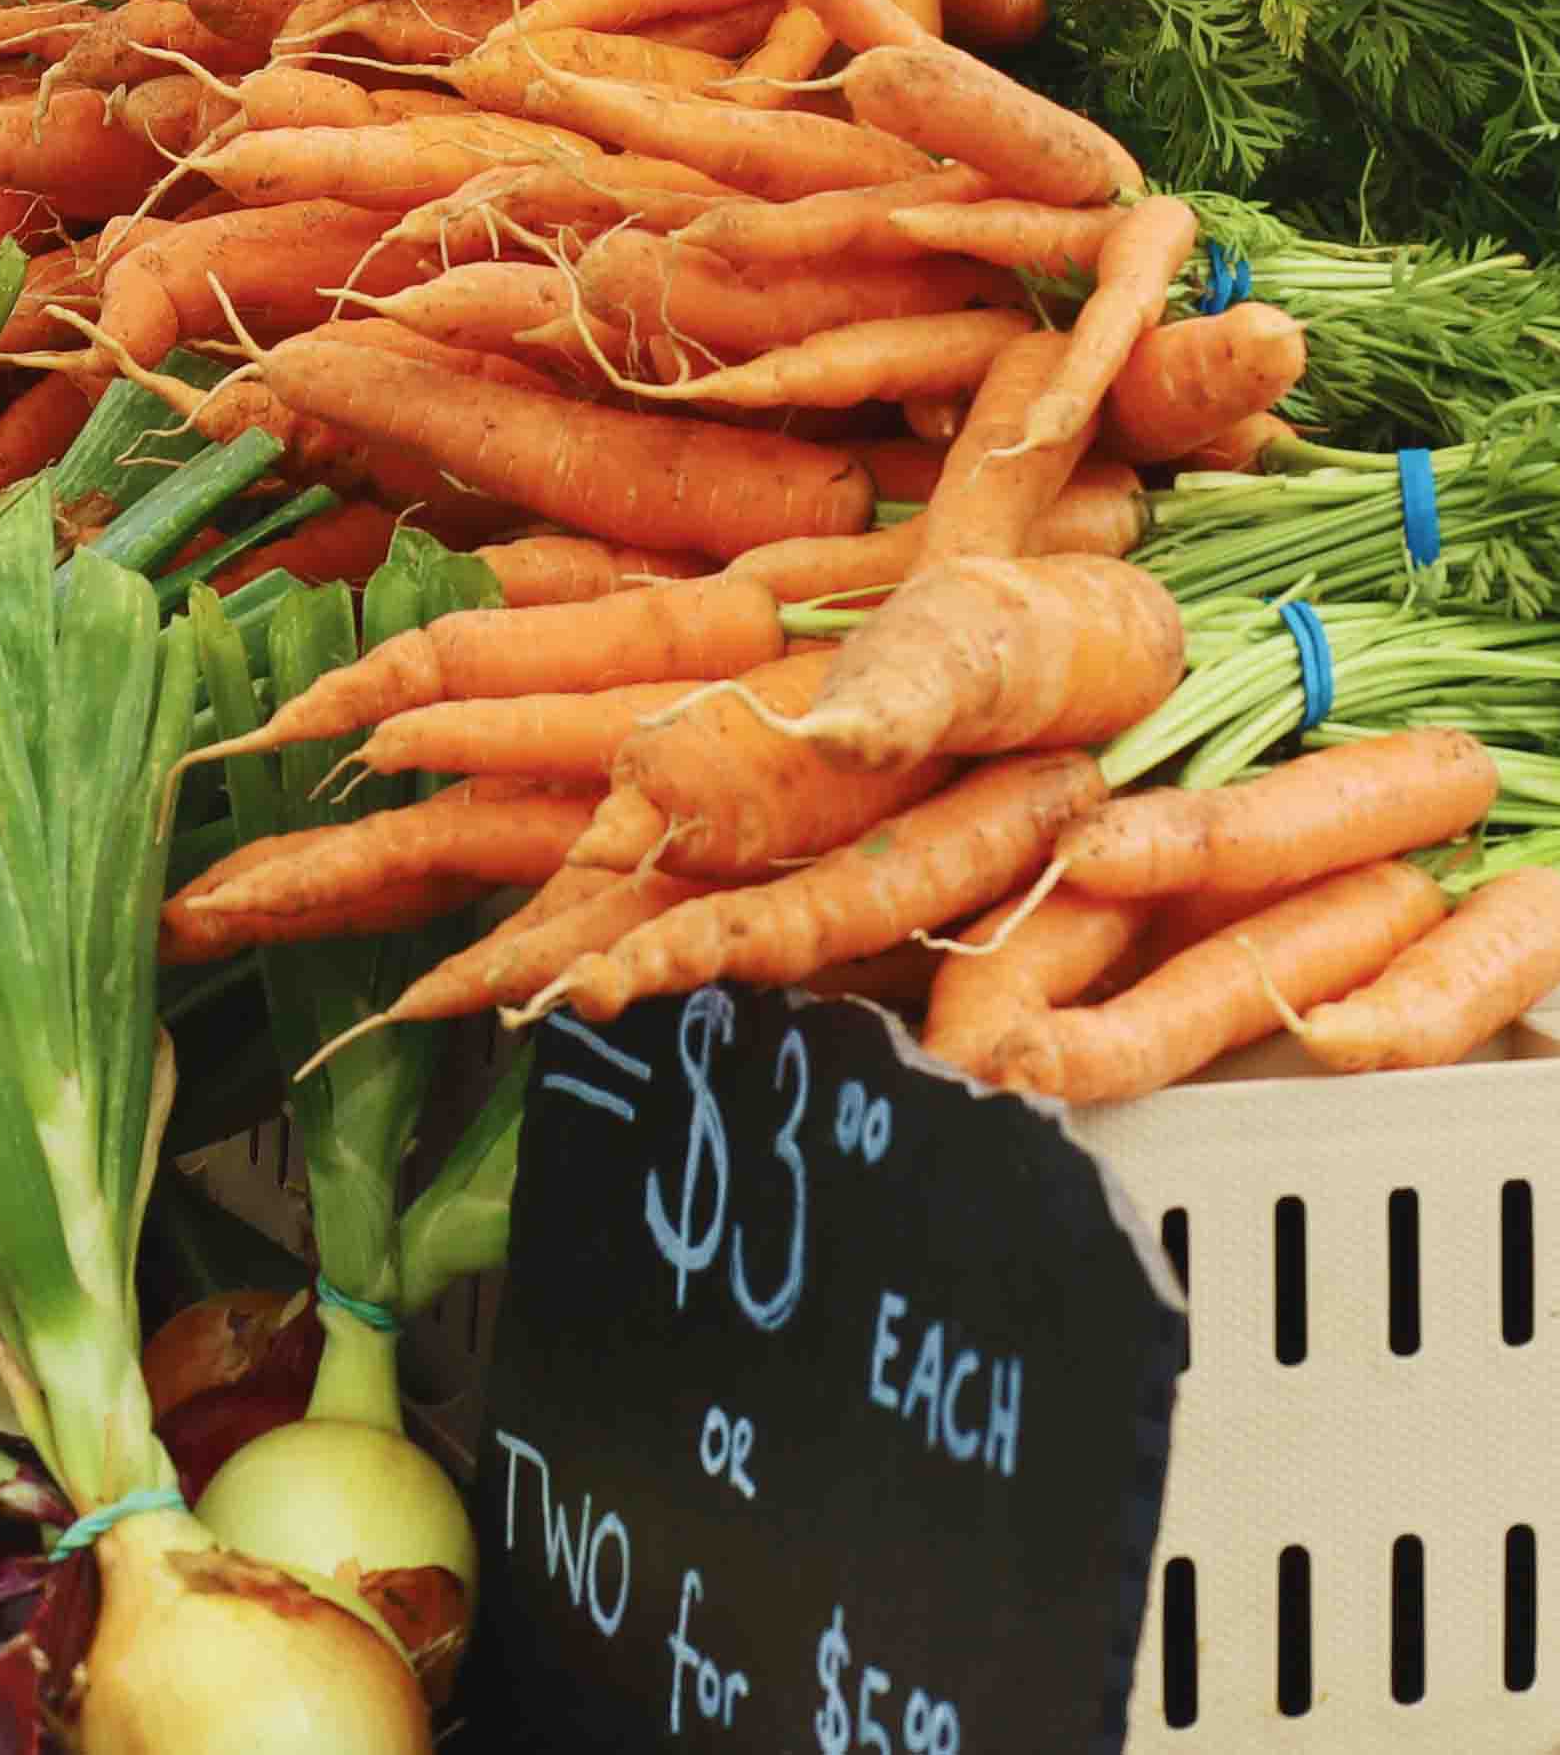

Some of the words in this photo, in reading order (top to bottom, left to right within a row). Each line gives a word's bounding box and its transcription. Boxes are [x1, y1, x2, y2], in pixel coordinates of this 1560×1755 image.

[698, 1406, 757, 1500] OR
[869, 1290, 1024, 1477] EACH
[496, 1429, 631, 1637] TWO
[665, 1567, 750, 1735] for
